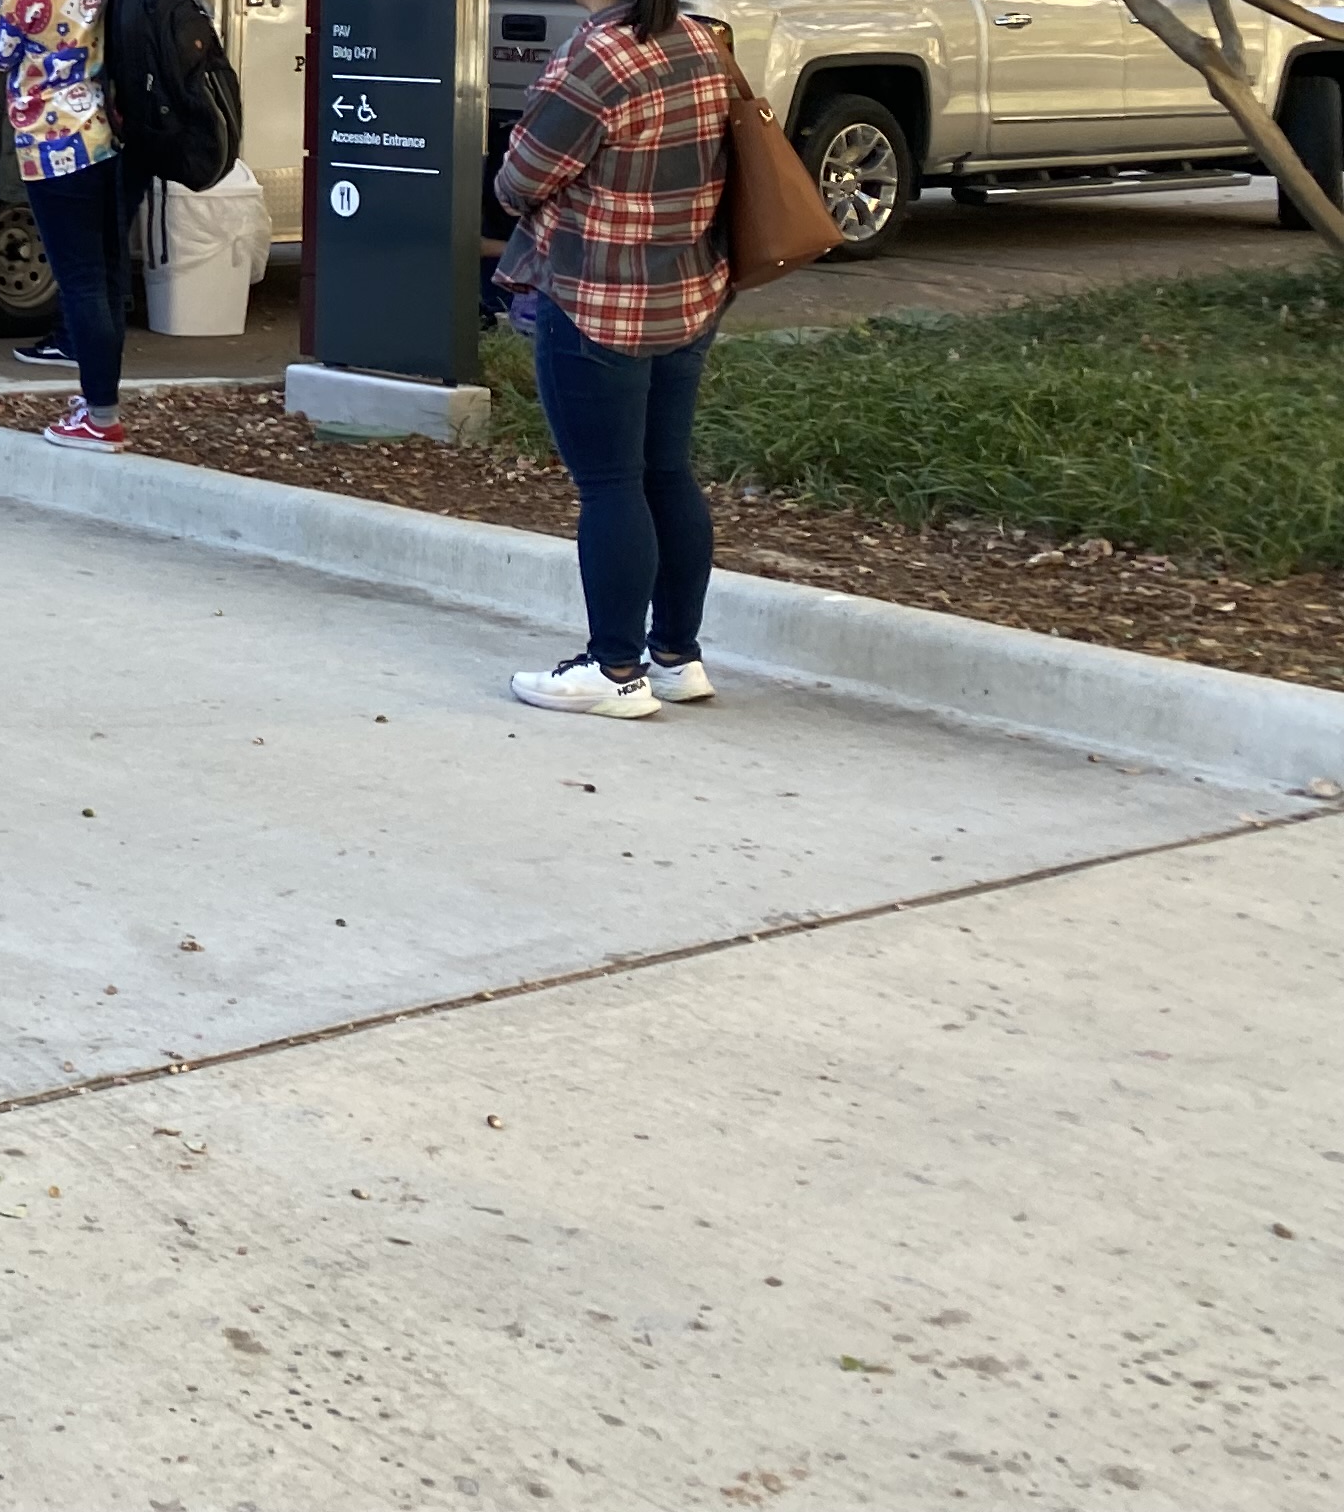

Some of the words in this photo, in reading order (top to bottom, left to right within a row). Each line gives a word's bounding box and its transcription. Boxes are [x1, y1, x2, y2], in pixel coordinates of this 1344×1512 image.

[332, 24, 351, 38] PAV
[332, 46, 352, 61] Bldg
[354, 46, 377, 60] 0471
[493, 47, 551, 64] GMC
[331, 130, 381, 145] Accessible
[383, 133, 426, 148] Entrance
